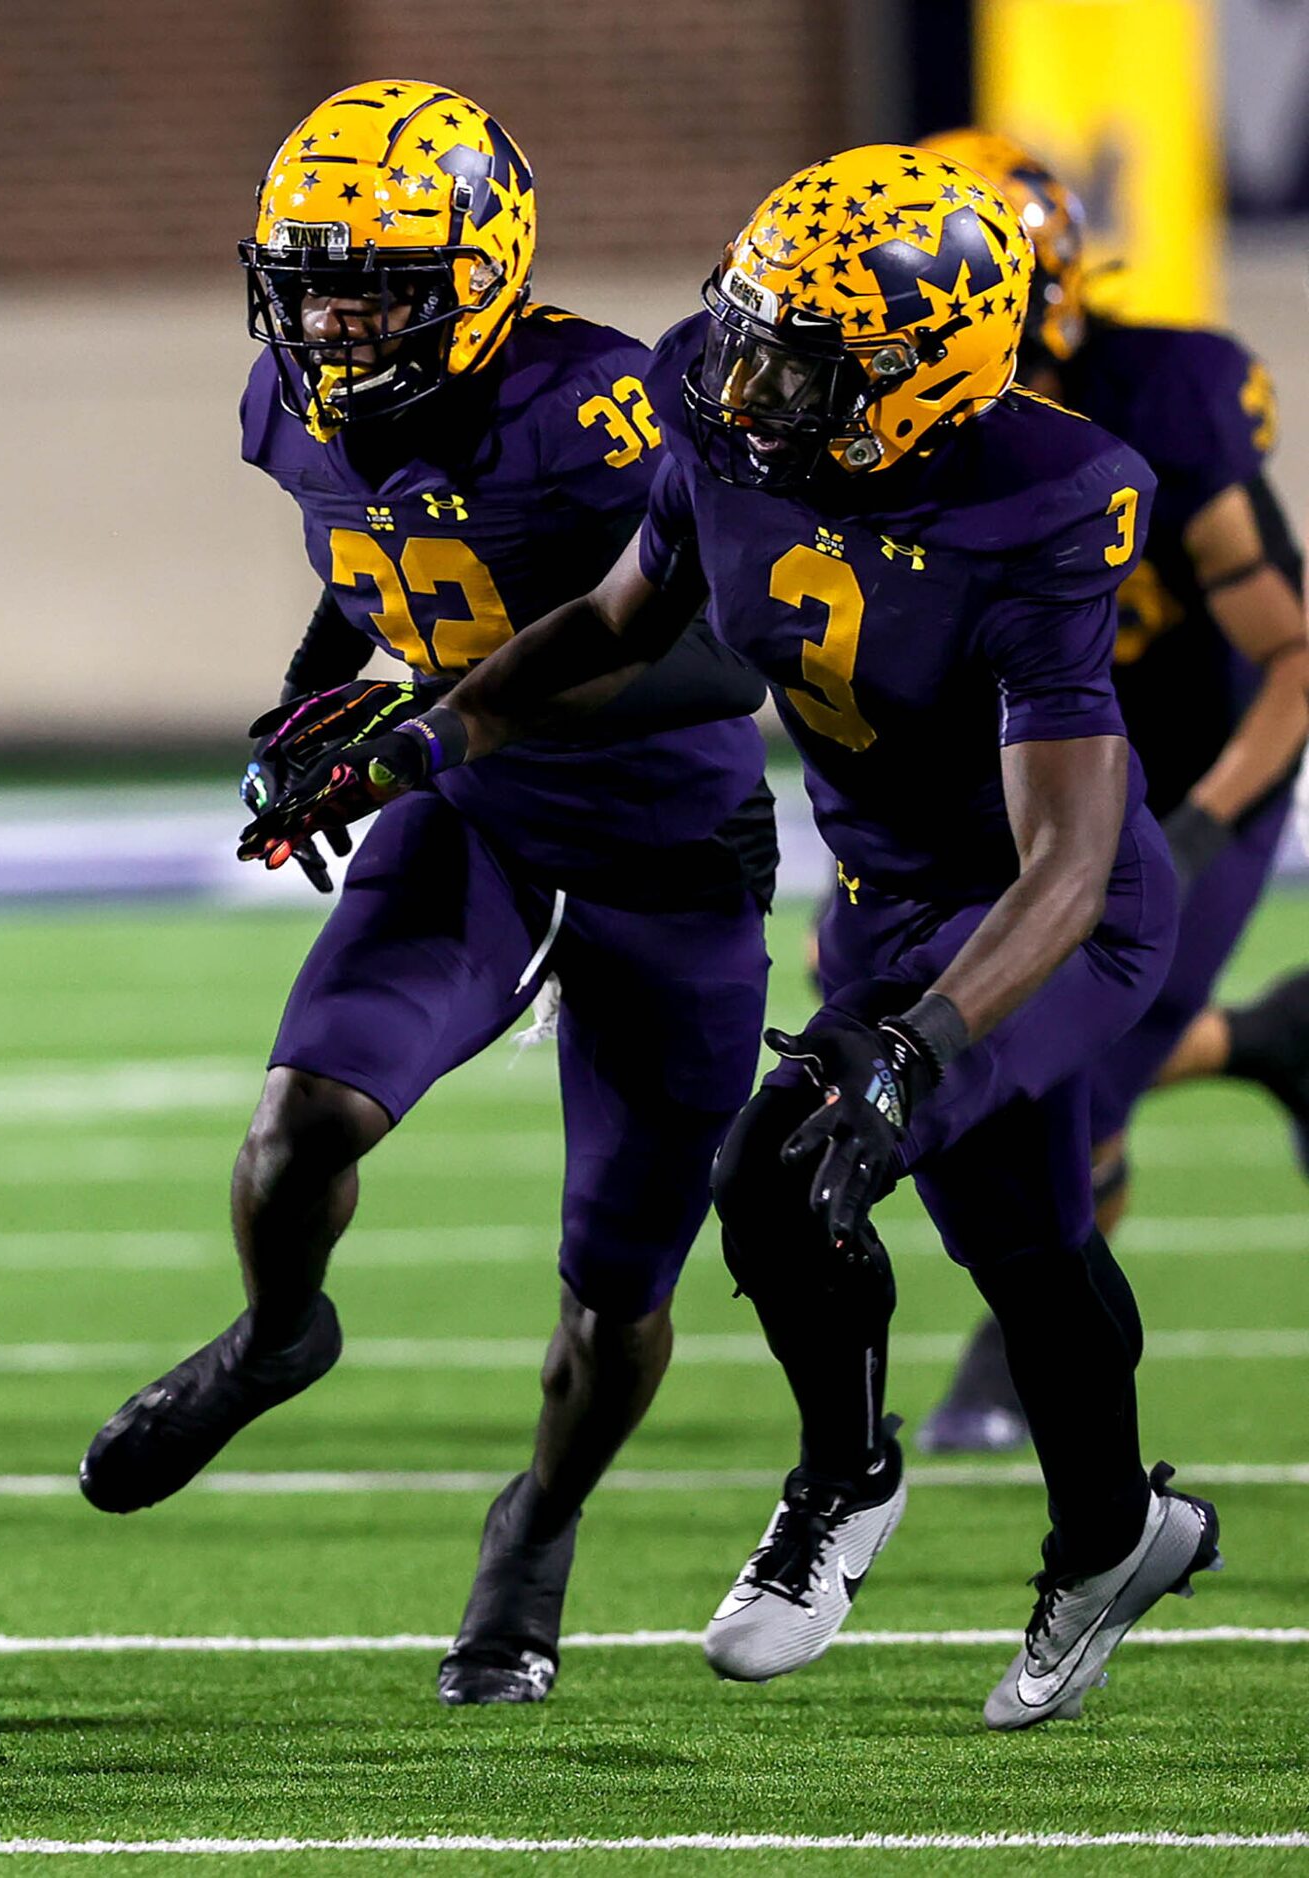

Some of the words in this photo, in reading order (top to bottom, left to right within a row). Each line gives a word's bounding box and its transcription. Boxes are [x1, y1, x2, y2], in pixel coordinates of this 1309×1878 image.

[857, 205, 1005, 333] M
[577, 375, 662, 469] 32
[1104, 486, 1139, 567] 3
[769, 543, 878, 752] 3
